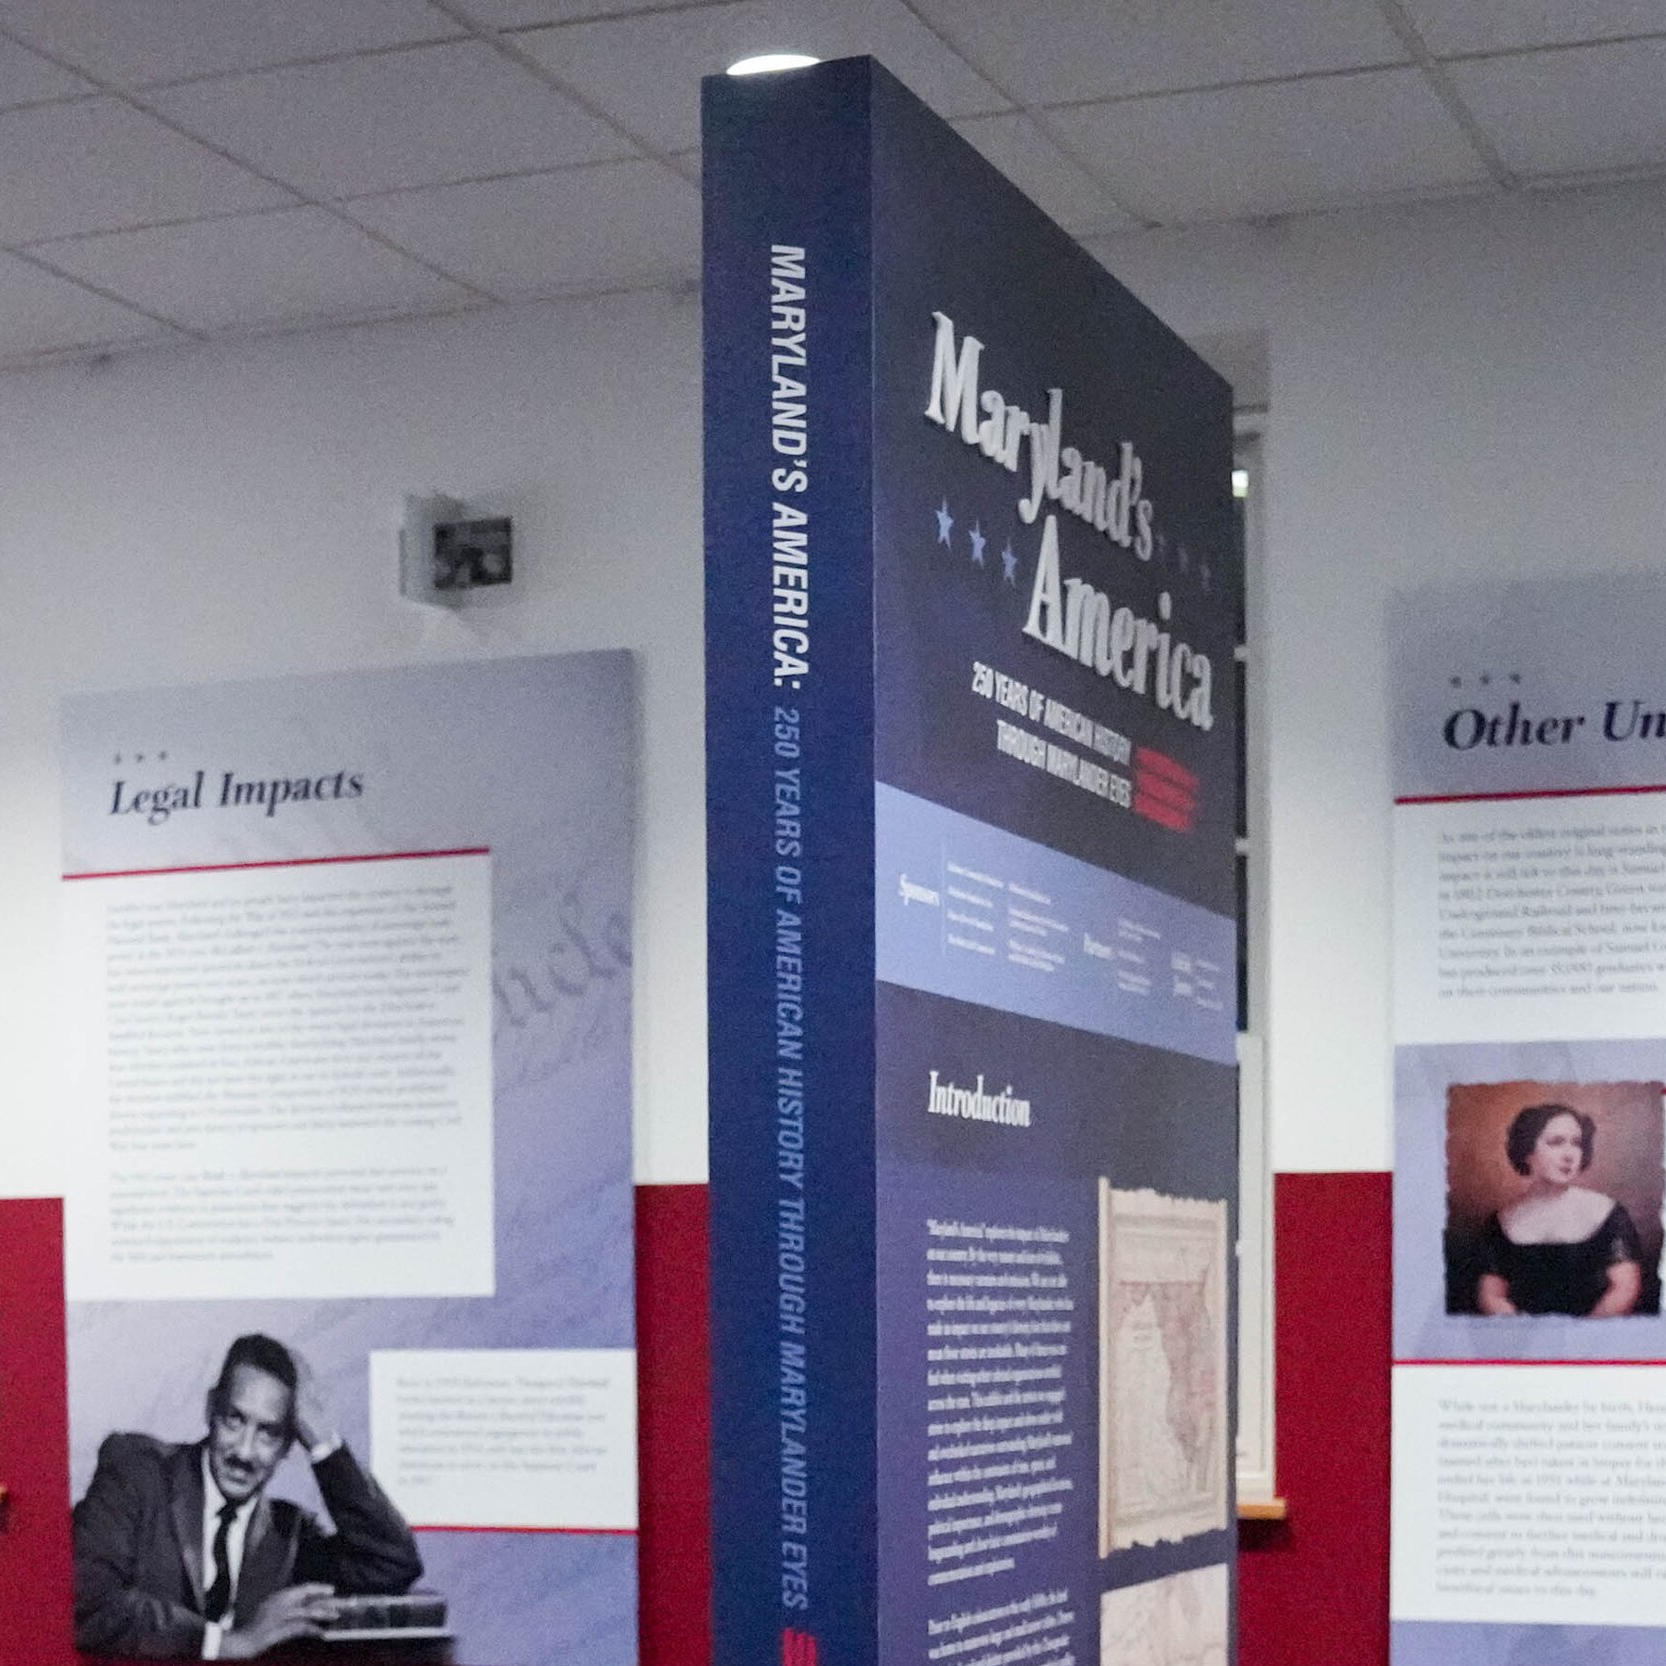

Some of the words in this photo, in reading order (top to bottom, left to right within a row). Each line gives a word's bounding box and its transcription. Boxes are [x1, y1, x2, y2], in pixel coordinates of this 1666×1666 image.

[770, 244, 808, 493] MARYLAND'S
[925, 311, 1154, 562] Maryland's
[771, 502, 810, 689] AMERICA:
[1021, 514, 1214, 731] America
[774, 706, 800, 759] 250
[971, 661, 994, 699] 250
[995, 670, 1029, 716] YEARS
[1029, 689, 1045, 722] OF
[1443, 700, 1585, 752] Other
[110, 769, 205, 825] Legal
[219, 769, 365, 818] Impacts
[774, 768, 802, 858] YEARS
[775, 866, 803, 904] OF
[775, 908, 804, 1060] AMERICAN
[777, 1066, 805, 1191] HISTORY
[927, 1071, 1033, 1128] Introduction
[778, 1199, 806, 1334] THROUGH
[779, 1343, 808, 1534] MARYLANDER
[782, 1543, 809, 1611] EYES
